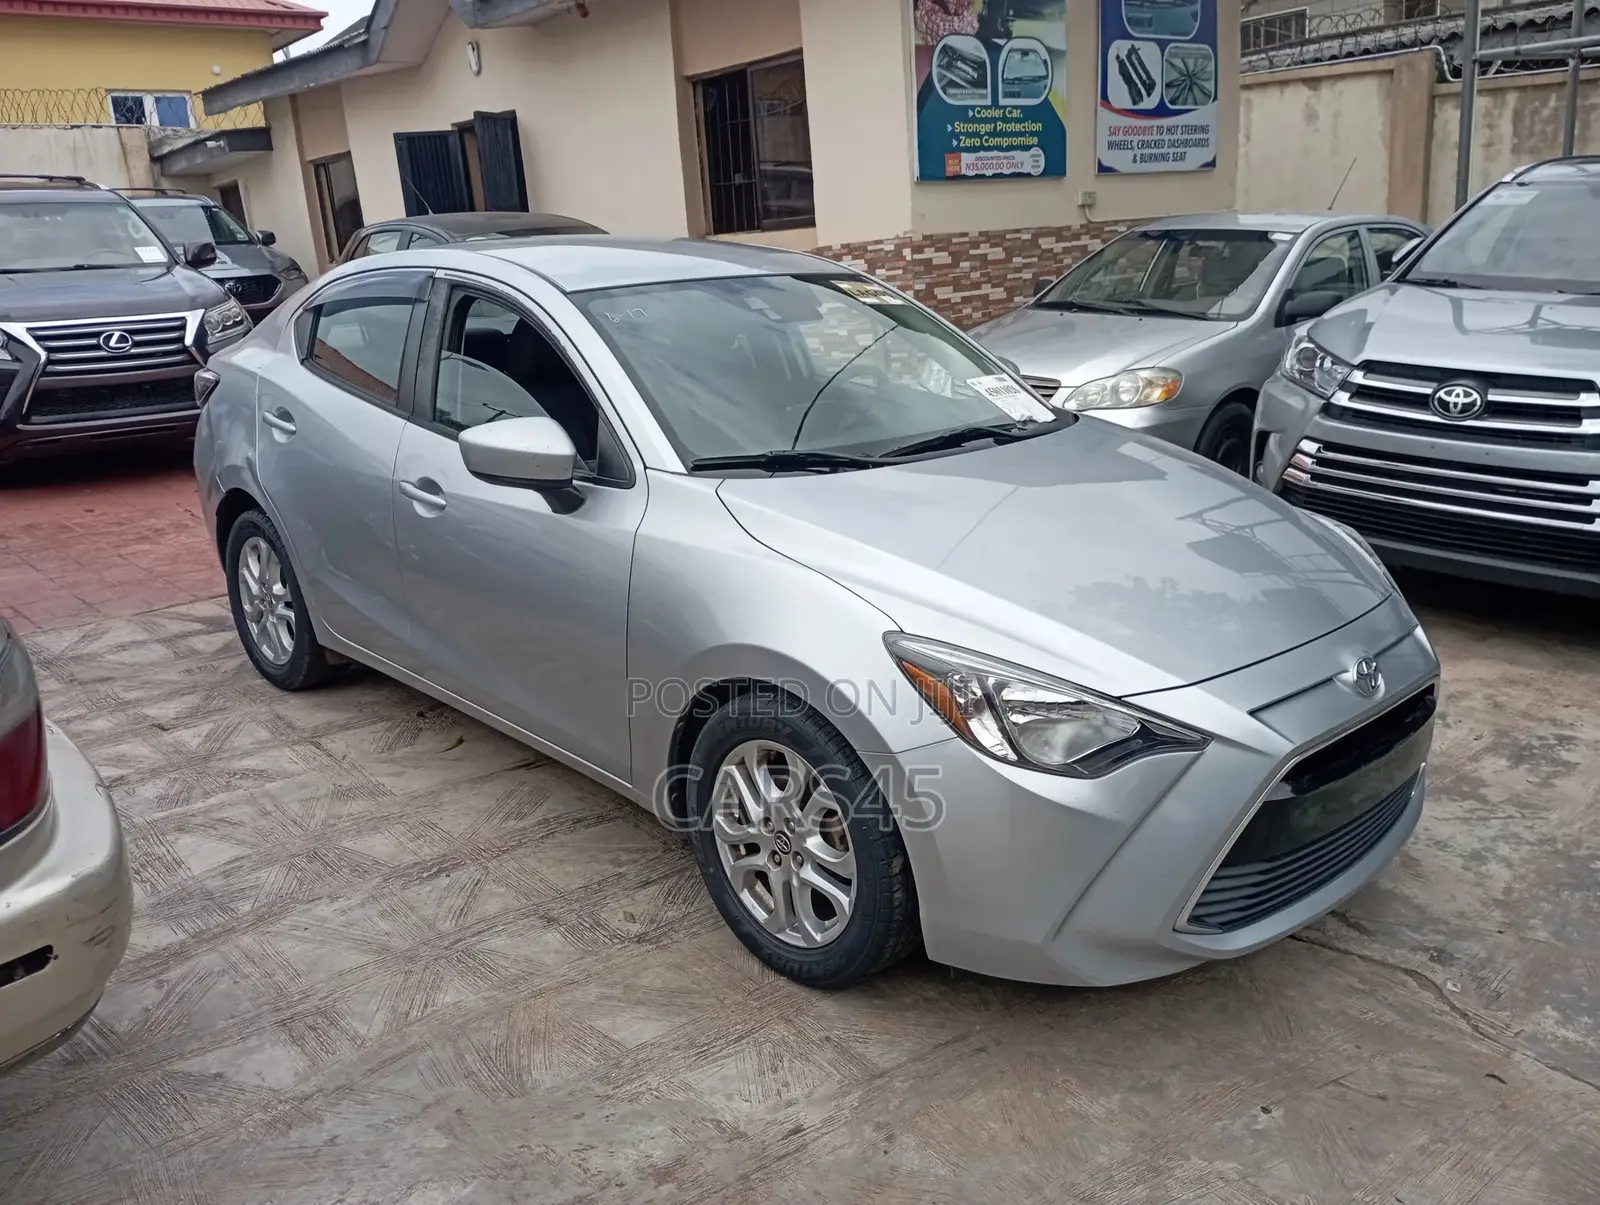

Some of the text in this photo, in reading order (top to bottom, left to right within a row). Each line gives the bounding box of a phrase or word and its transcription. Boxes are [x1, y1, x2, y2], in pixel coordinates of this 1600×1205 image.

[974, 106, 1023, 118] Cooler Car.
[954, 120, 1042, 134] Stronger Protection
[1108, 124, 1210, 137] SAY GOODBYE TO HOT STEERING
[959, 134, 1038, 148] Zero Compromise
[1107, 138, 1210, 151] WHEELS, CRACKED DASHBOARDS
[1132, 151, 1187, 164] & BURNING SEAT
[1005, 161, 1024, 170] ONLY
